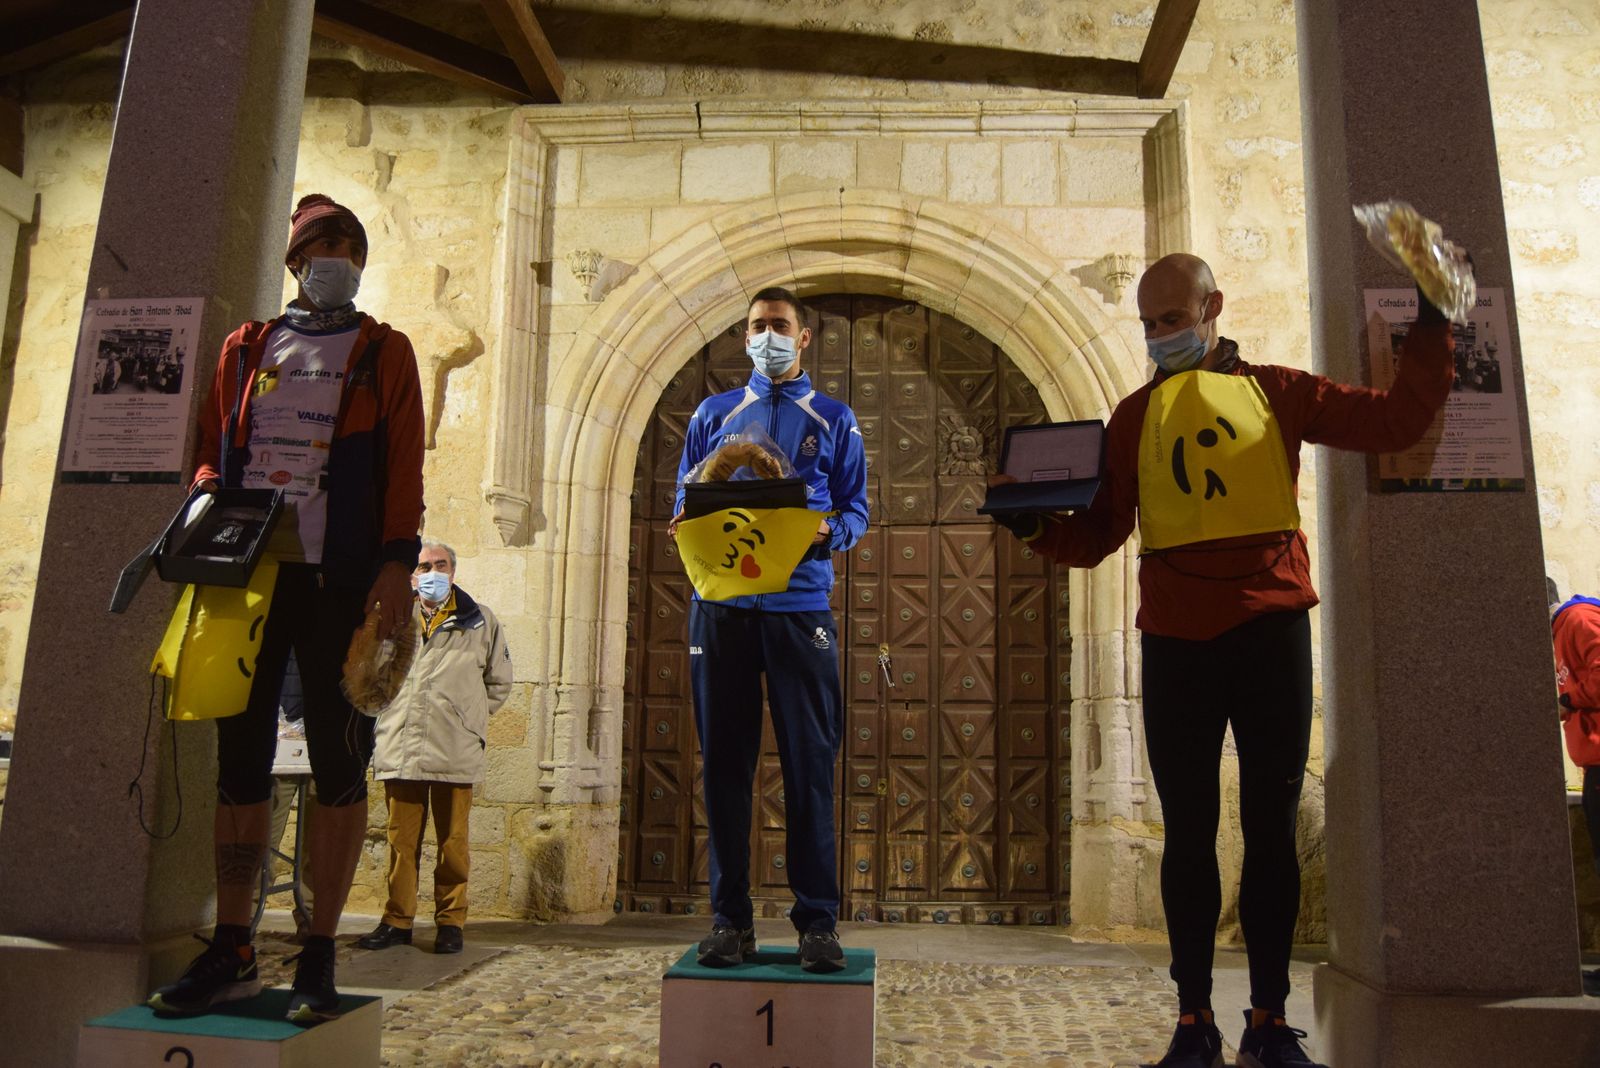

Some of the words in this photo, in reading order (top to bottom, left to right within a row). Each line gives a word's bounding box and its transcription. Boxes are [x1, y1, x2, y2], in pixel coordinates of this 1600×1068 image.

[129, 305, 143, 316] San
[146, 305, 172, 316] Antonio
[175, 304, 193, 316] Abad
[755, 999, 774, 1047] 1
